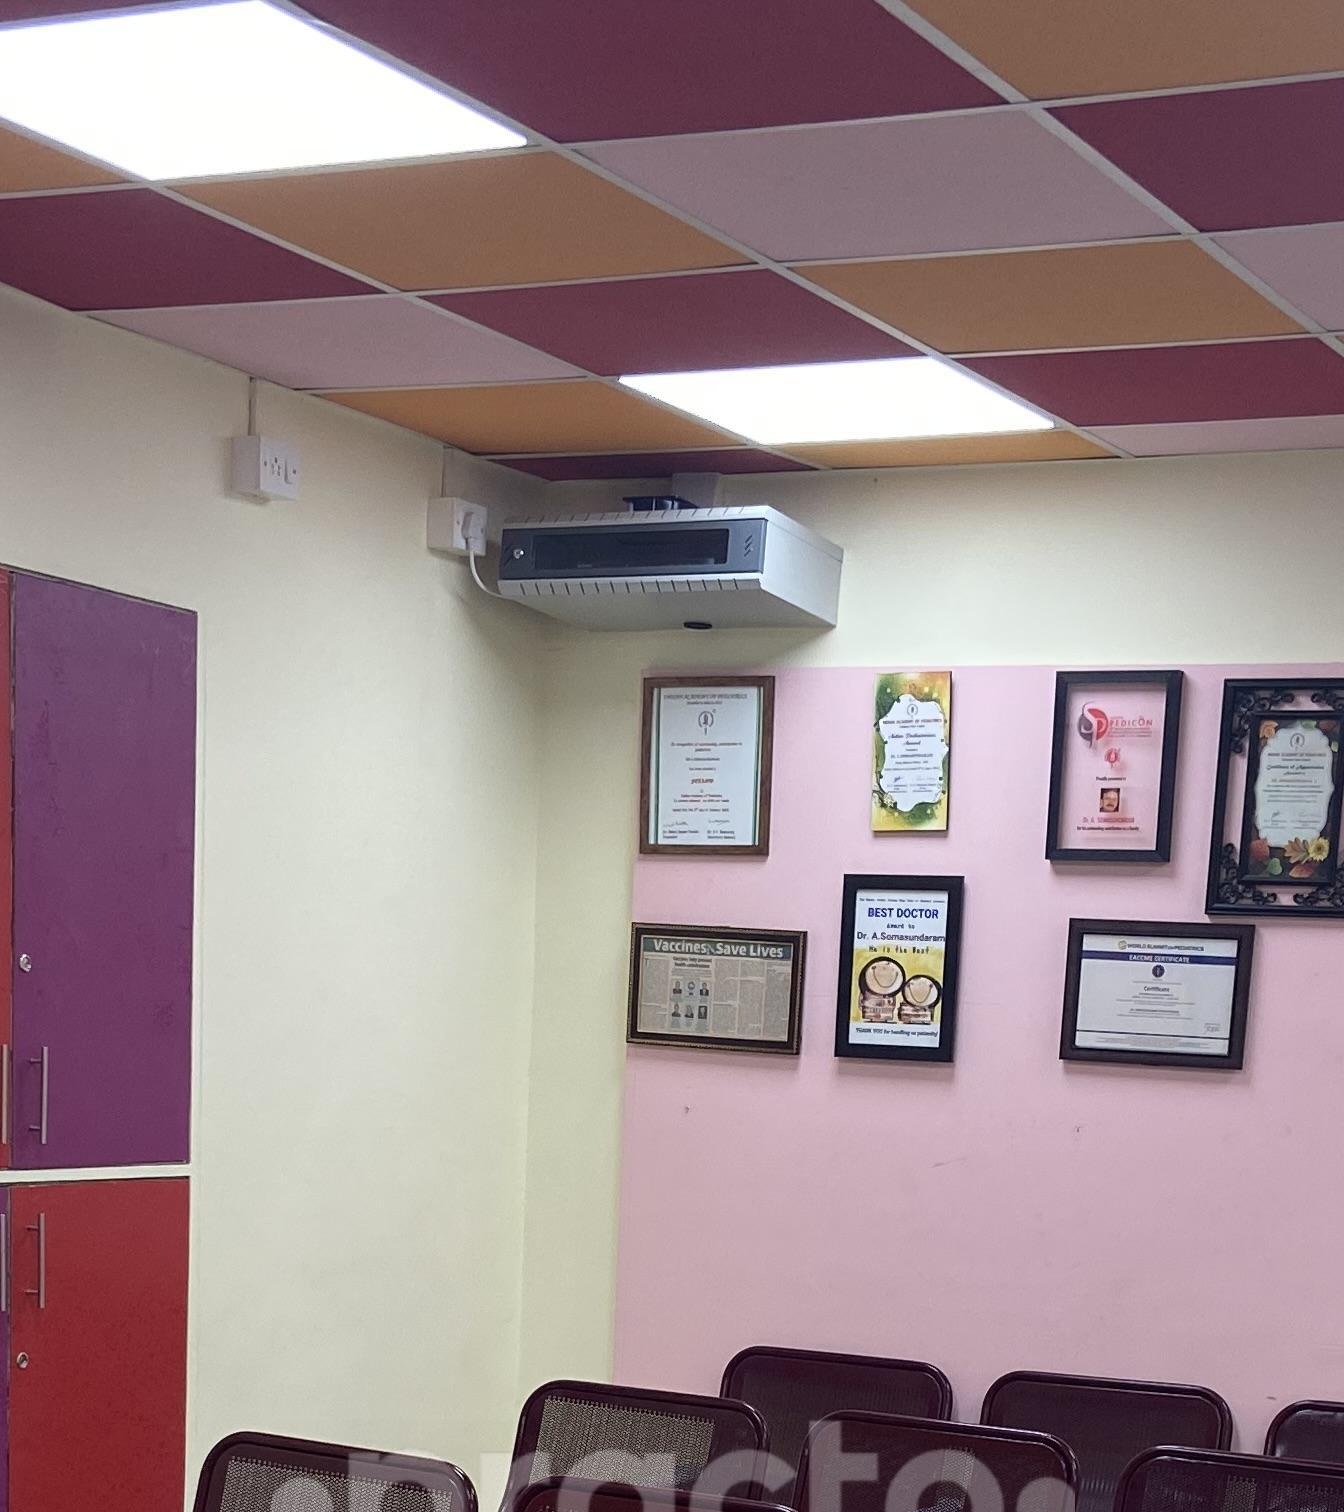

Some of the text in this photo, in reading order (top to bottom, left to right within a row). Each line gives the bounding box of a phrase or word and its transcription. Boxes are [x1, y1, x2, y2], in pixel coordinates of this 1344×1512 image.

[867, 907, 939, 919] BEST DOCTOR
[856, 931, 869, 940] Dr.
[653, 938, 783, 958] Vaccines Save Lives
[1143, 985, 1170, 993] Certificate
